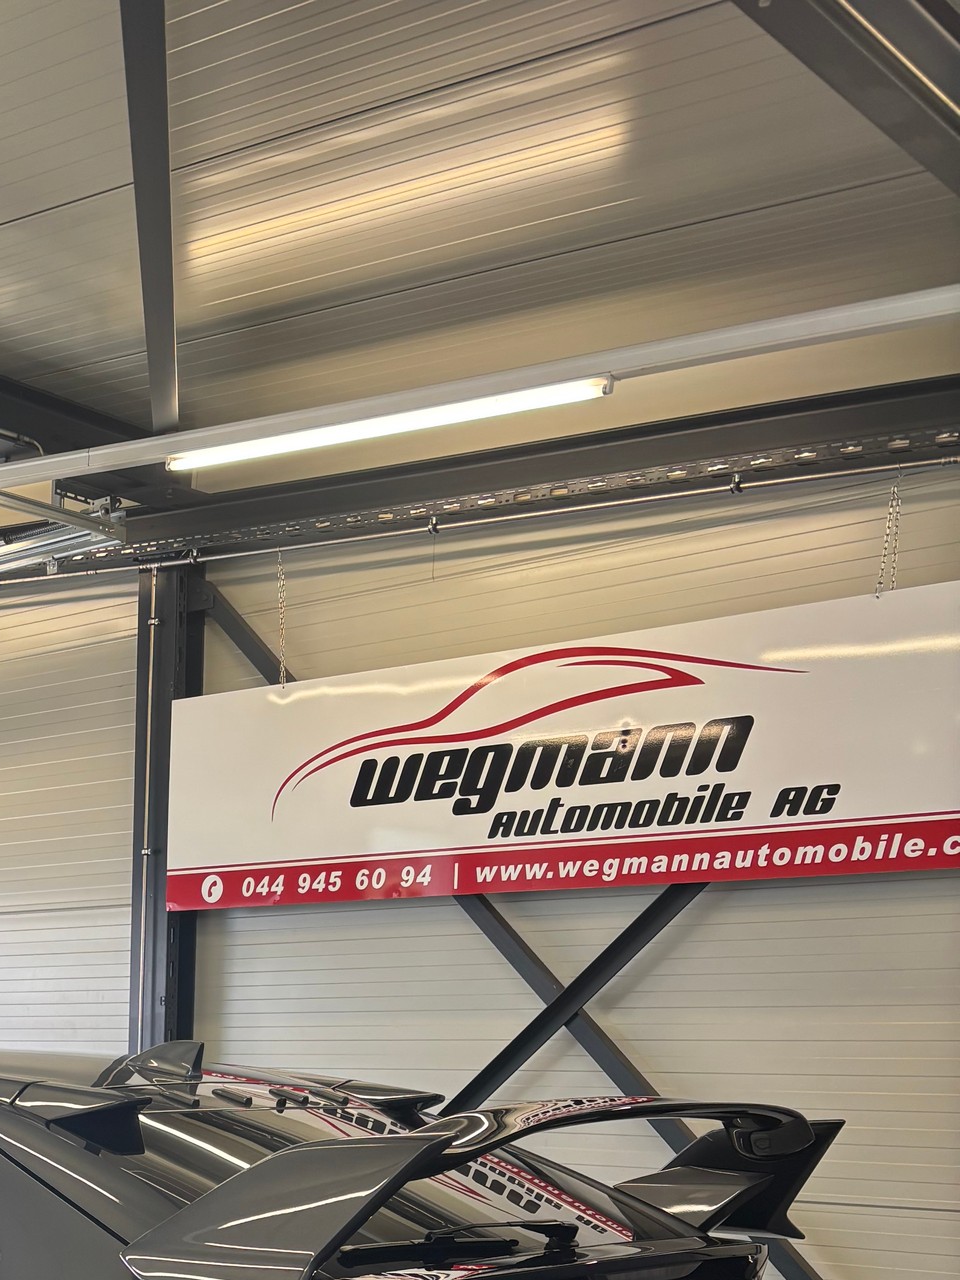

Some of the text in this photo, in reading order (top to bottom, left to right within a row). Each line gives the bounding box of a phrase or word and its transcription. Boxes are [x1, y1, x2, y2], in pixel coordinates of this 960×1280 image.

[349, 714, 755, 816] wegmann
[769, 783, 841, 818] AG
[241, 874, 285, 898] 044
[297, 870, 343, 894] 945
[355, 868, 386, 890] 60
[400, 864, 432, 888] 94
